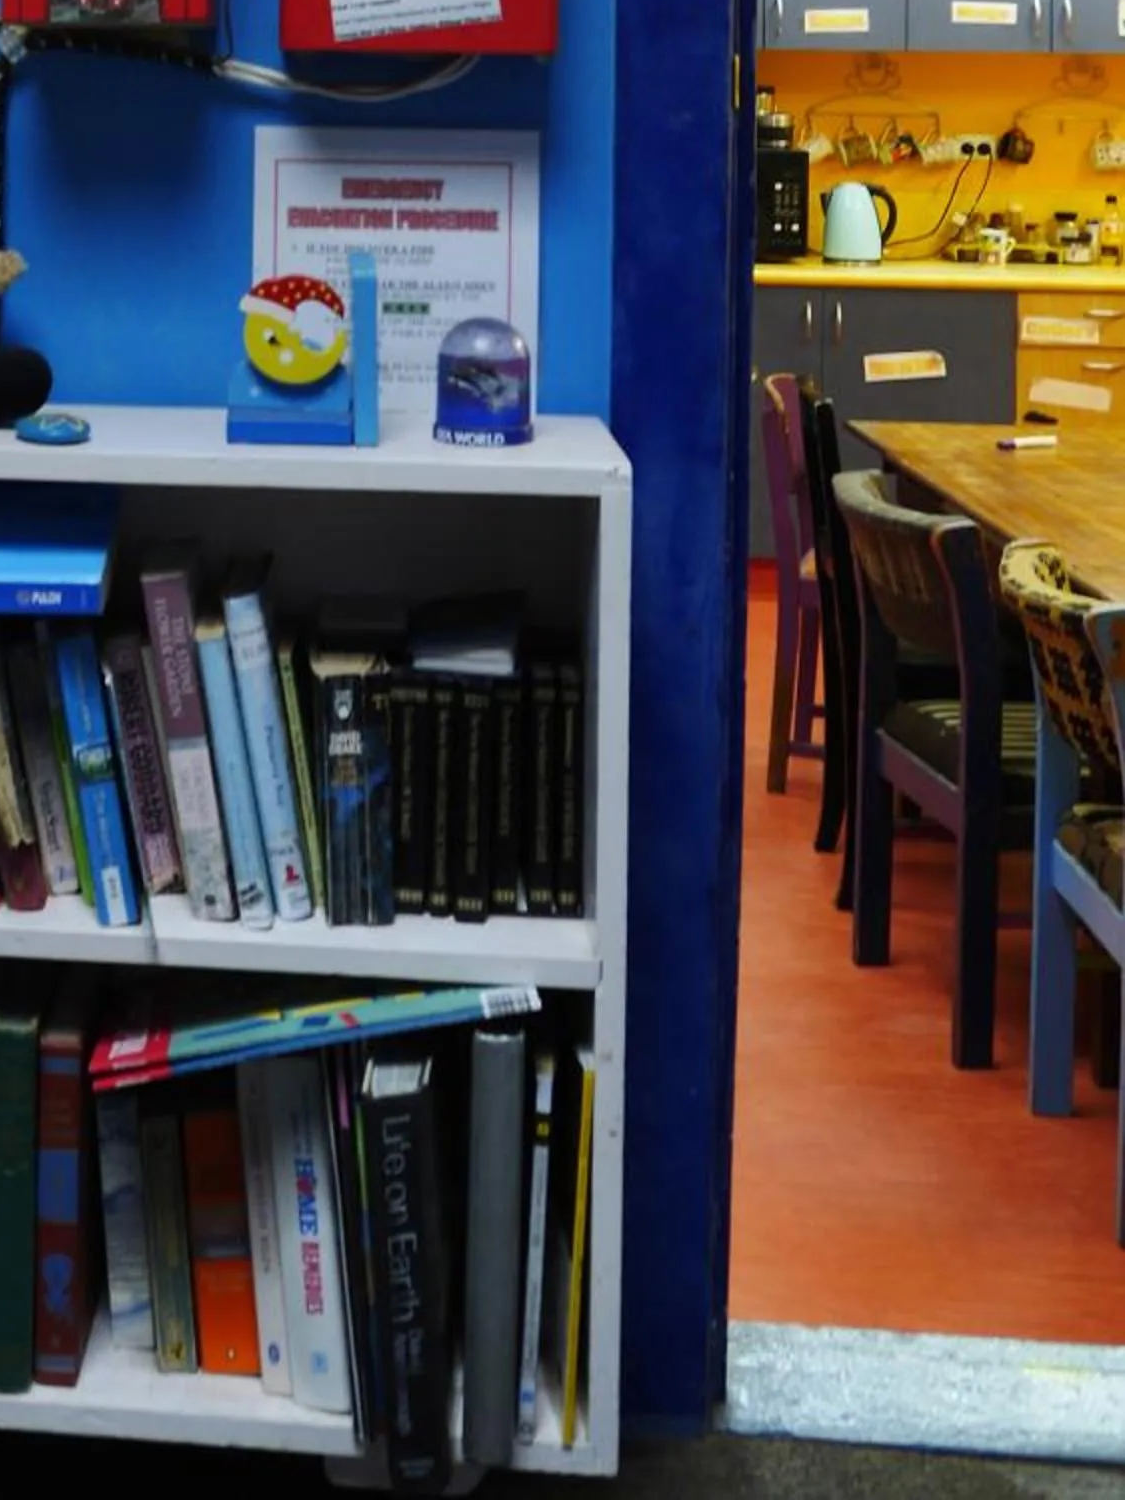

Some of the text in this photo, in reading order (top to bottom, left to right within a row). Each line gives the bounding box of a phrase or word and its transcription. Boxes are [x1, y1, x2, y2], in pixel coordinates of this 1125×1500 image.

[454, 431, 506, 448] WORLD
[164, 657, 183, 717] GARDEN
[294, 1156, 323, 1316] HOME REMEDIES
[381, 1113, 421, 1324] Life on Earth
